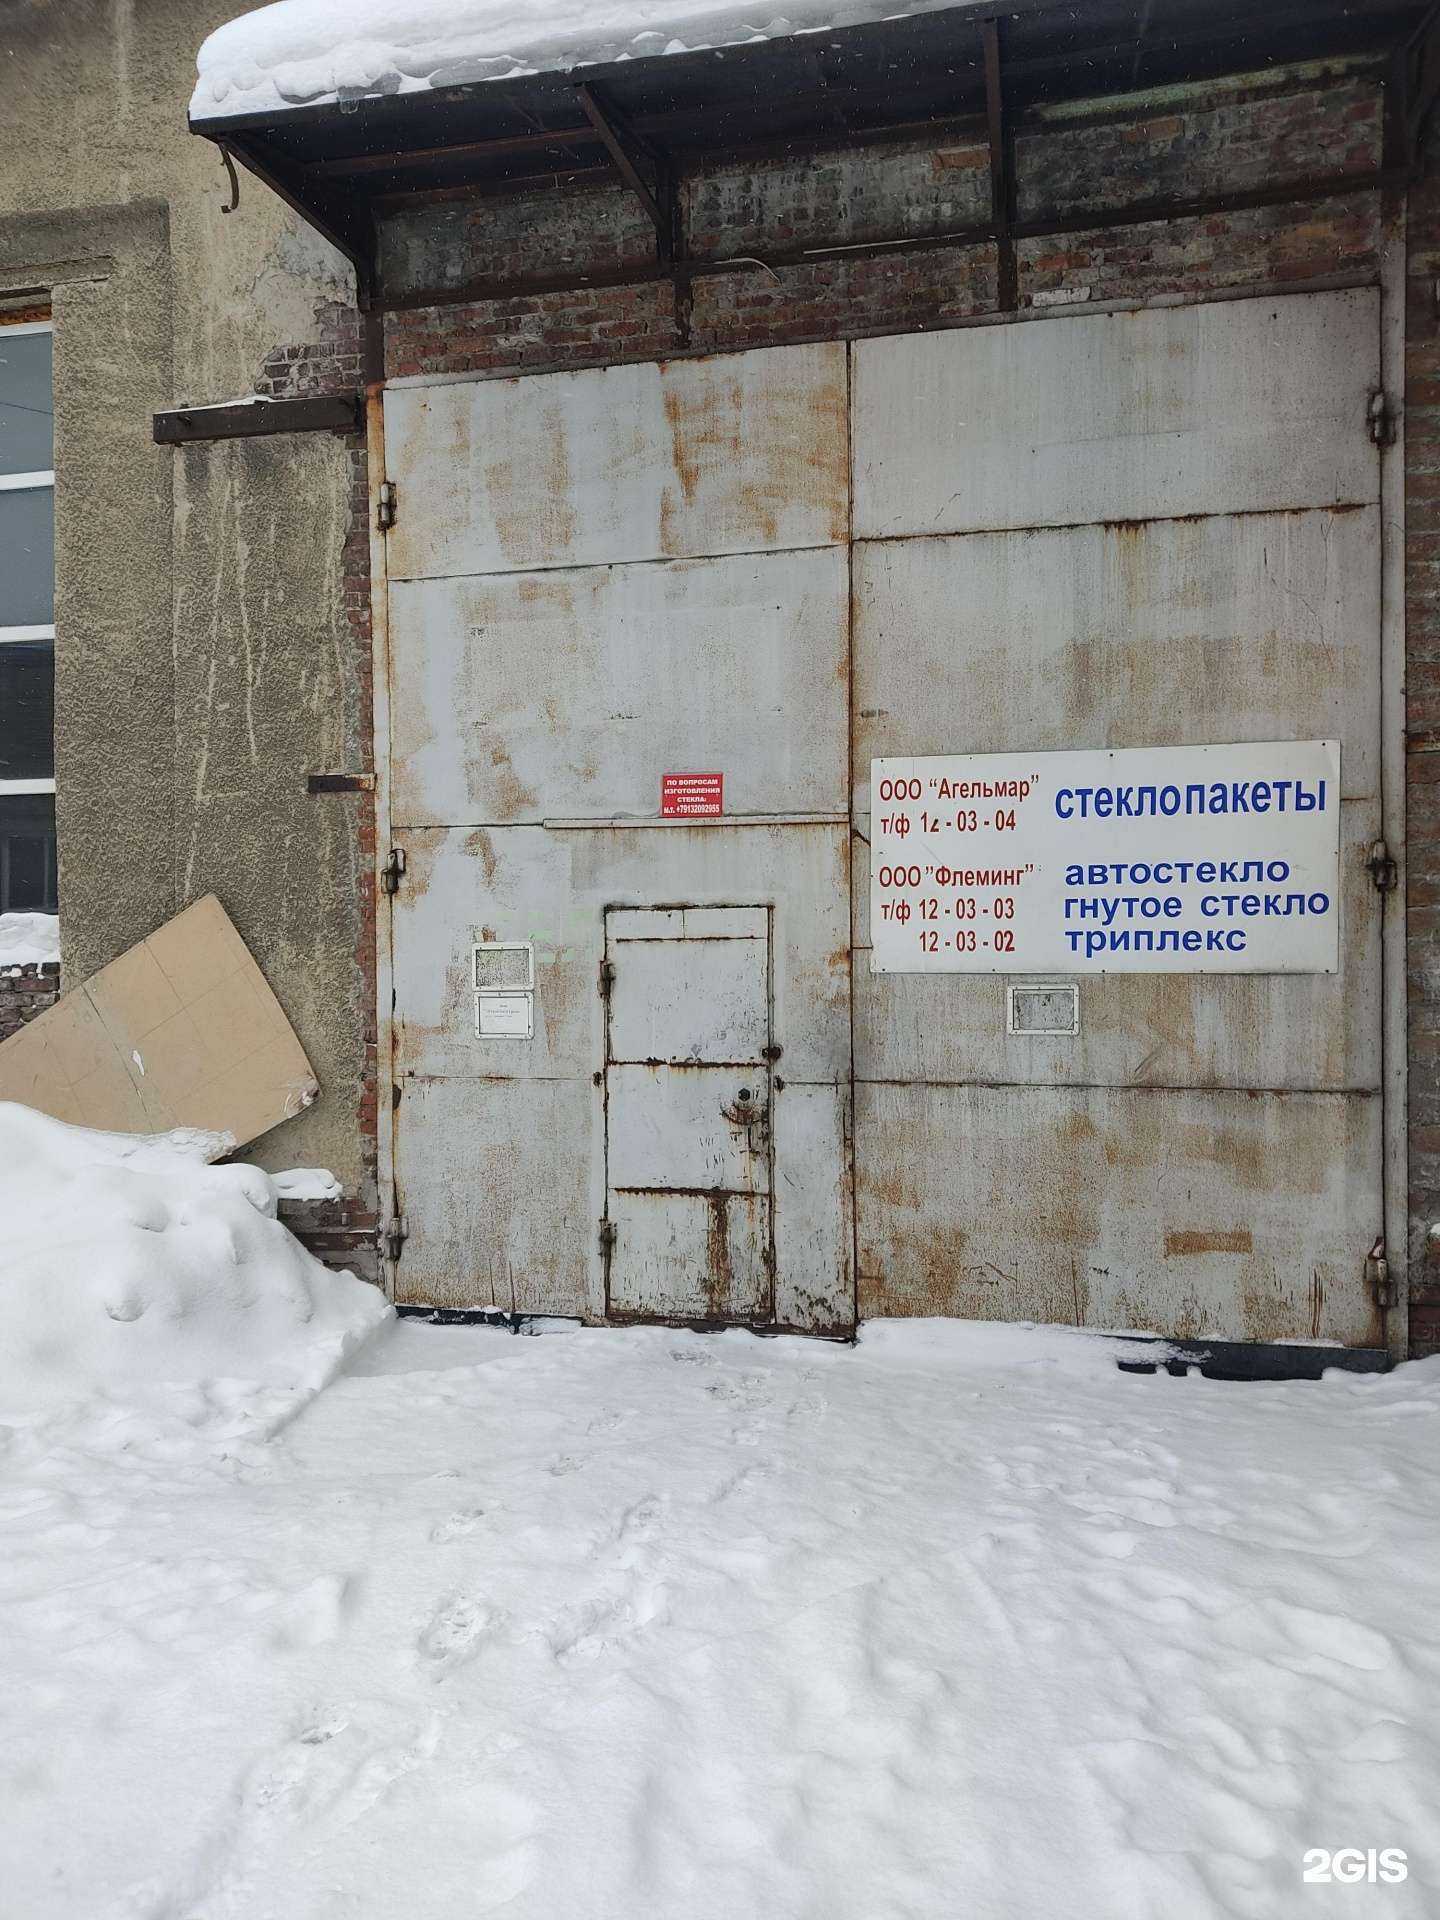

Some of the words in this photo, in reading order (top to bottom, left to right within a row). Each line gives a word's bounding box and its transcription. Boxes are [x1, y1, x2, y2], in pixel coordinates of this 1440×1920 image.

[664, 787, 720, 795] ИЗГОТОВЛЕНИЯ
[880, 779, 921, 800] ООО
[1055, 780, 1326, 820] стеклопакеты
[881, 812, 910, 838] т/ф
[1064, 860, 1290, 887] автостекло
[881, 899, 911, 925] т/ф
[1063, 896, 1183, 927] гнутое
[1200, 892, 1329, 918] стекло
[1064, 928, 1246, 960] триплекс
